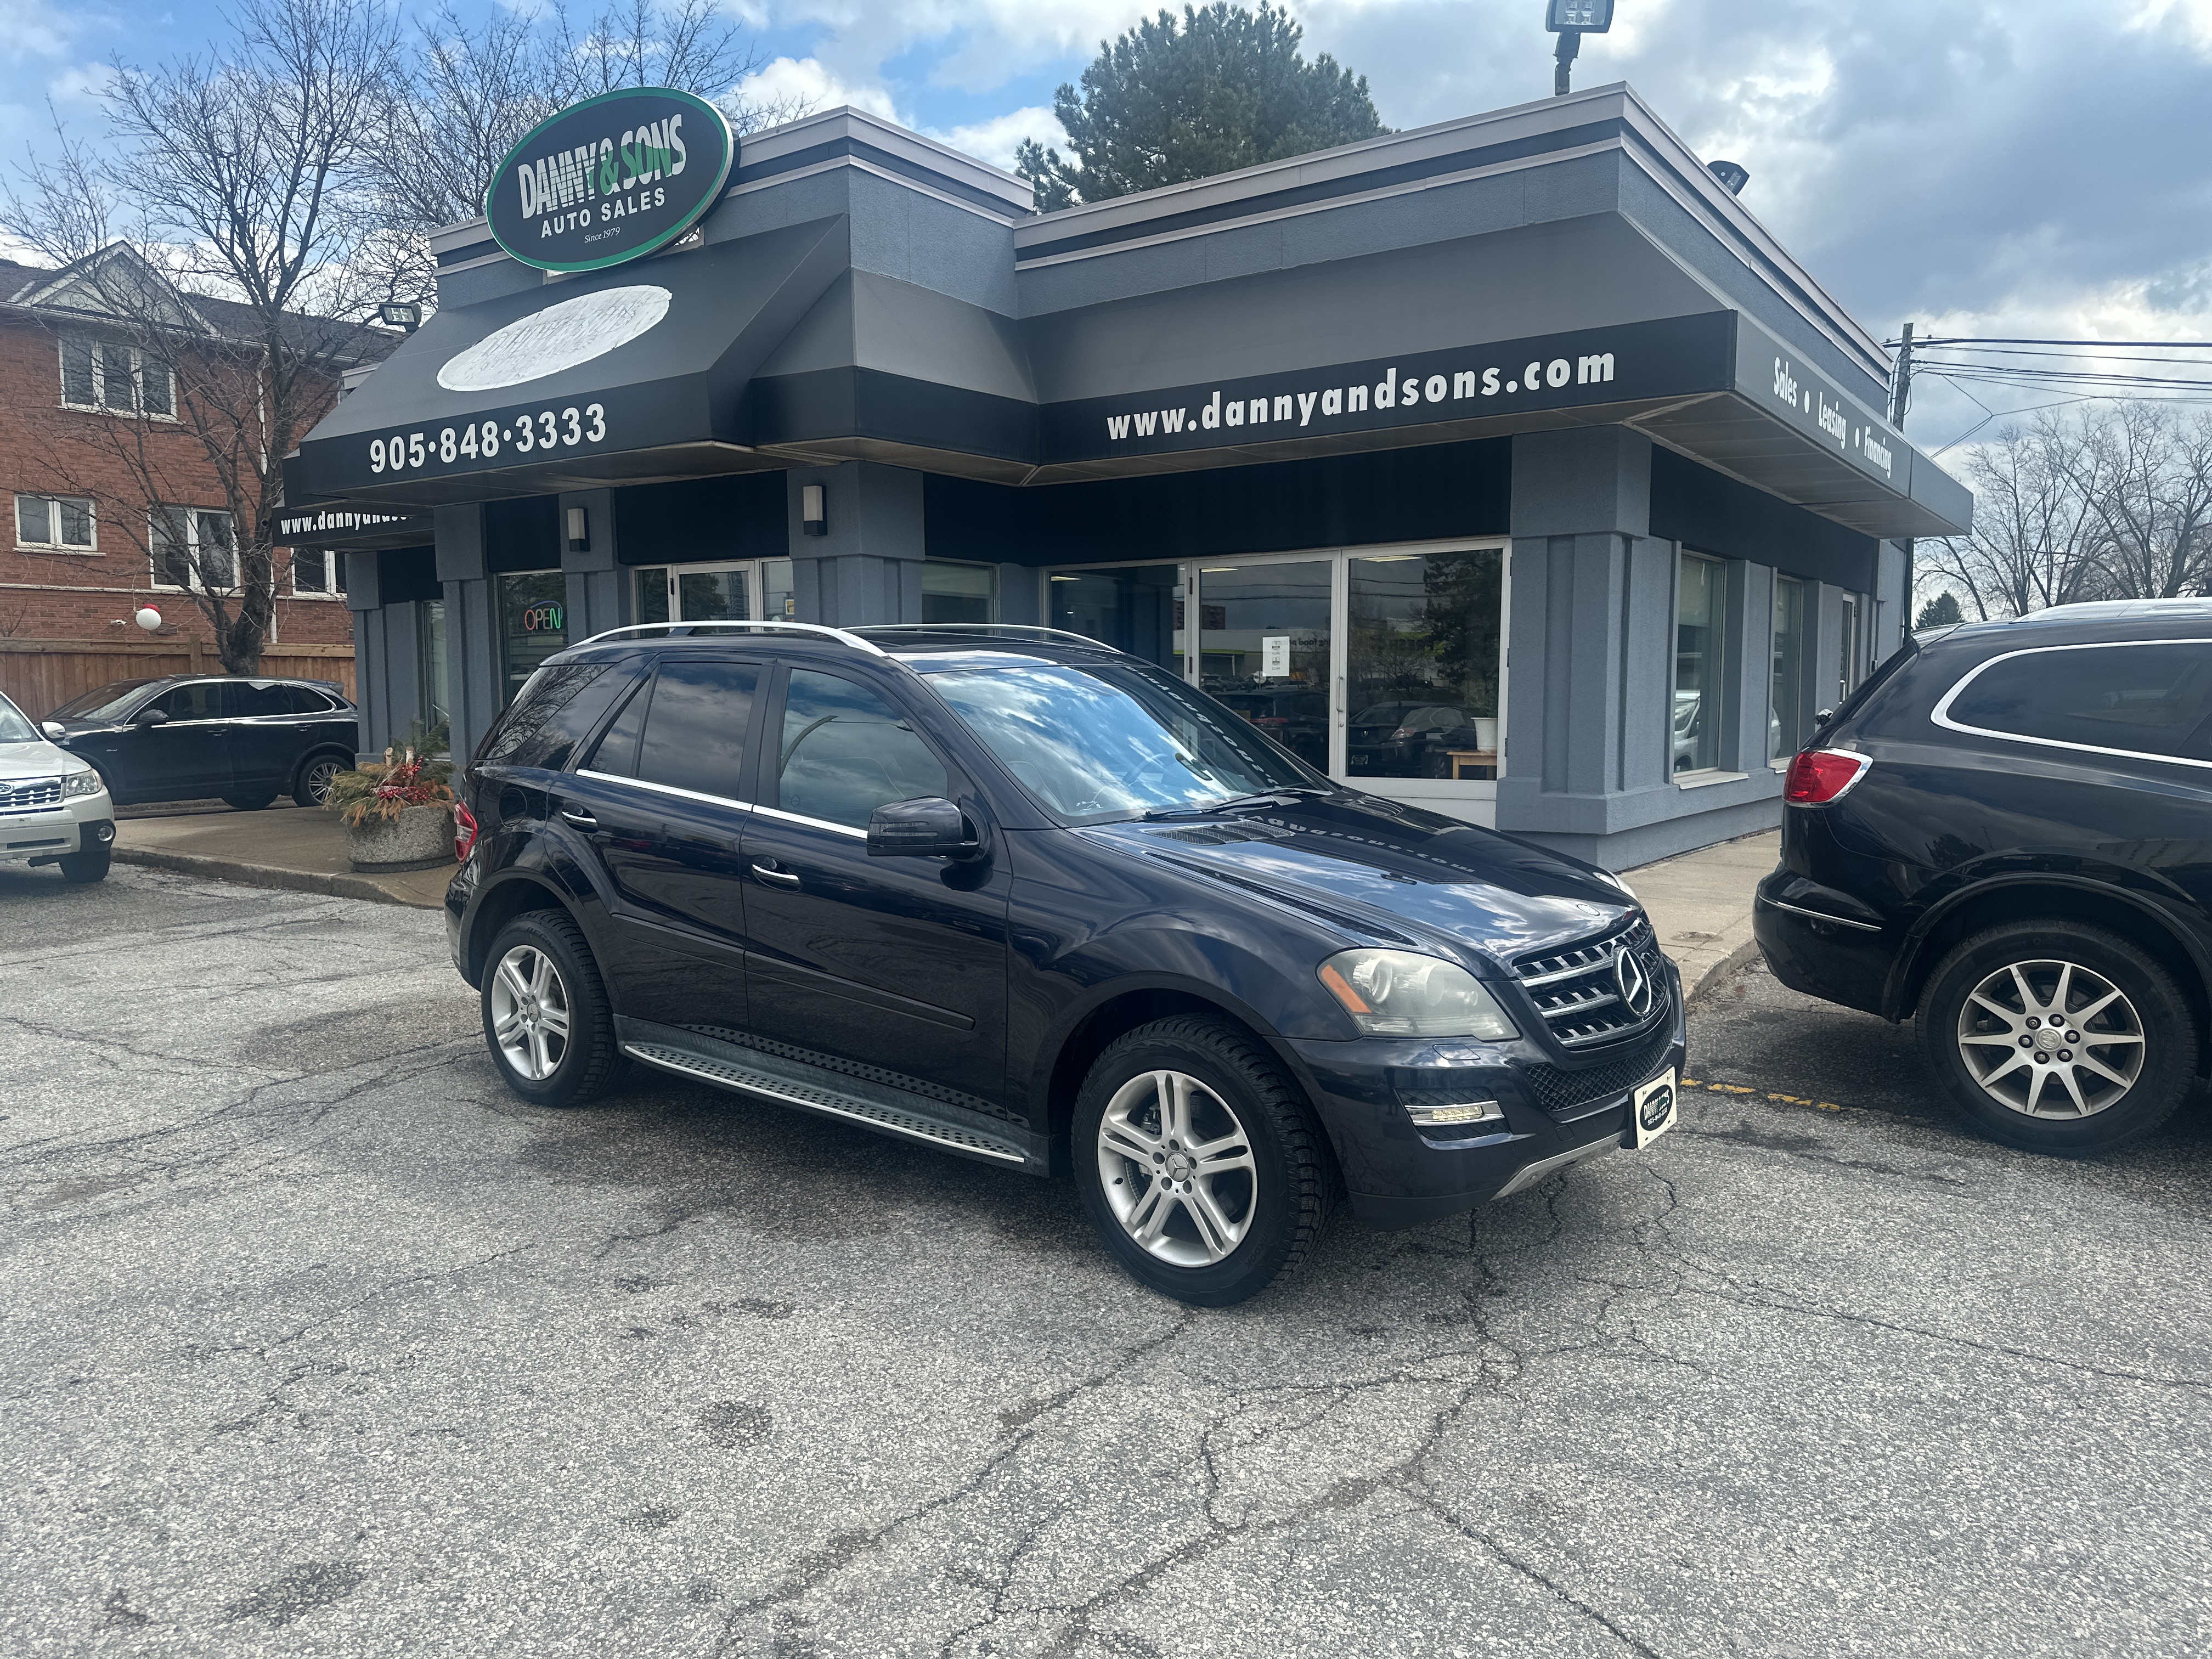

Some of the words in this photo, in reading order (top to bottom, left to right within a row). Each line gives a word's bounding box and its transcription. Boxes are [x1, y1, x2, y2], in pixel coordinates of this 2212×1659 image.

[517, 141, 597, 219] DANNY
[600, 137, 621, 196] &
[620, 114, 686, 190] SONS
[541, 208, 591, 238] AUTO
[601, 187, 666, 222] SALES
[584, 232, 602, 244] Since
[603, 227, 621, 240] 1979
[1107, 352, 1615, 439] www.dannyandsons.com
[1774, 357, 1797, 407] Sales
[1818, 391, 1847, 449] Leasing
[1864, 426, 1892, 479] Financing
[524, 607, 561, 630] OPEN
